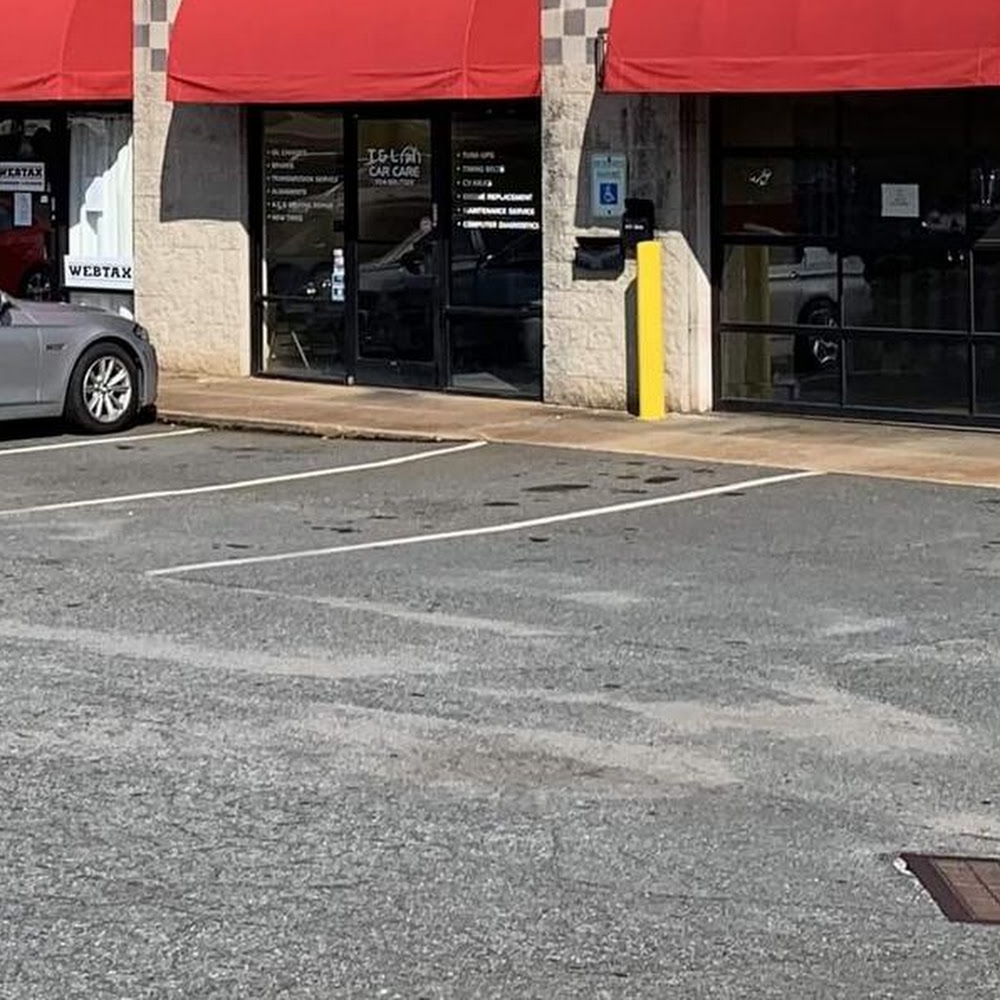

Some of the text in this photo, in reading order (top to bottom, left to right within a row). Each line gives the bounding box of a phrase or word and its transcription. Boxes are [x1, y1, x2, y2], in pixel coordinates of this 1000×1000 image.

[369, 165, 420, 178] CAR CARE
[68, 265, 132, 279] WEBTAX
